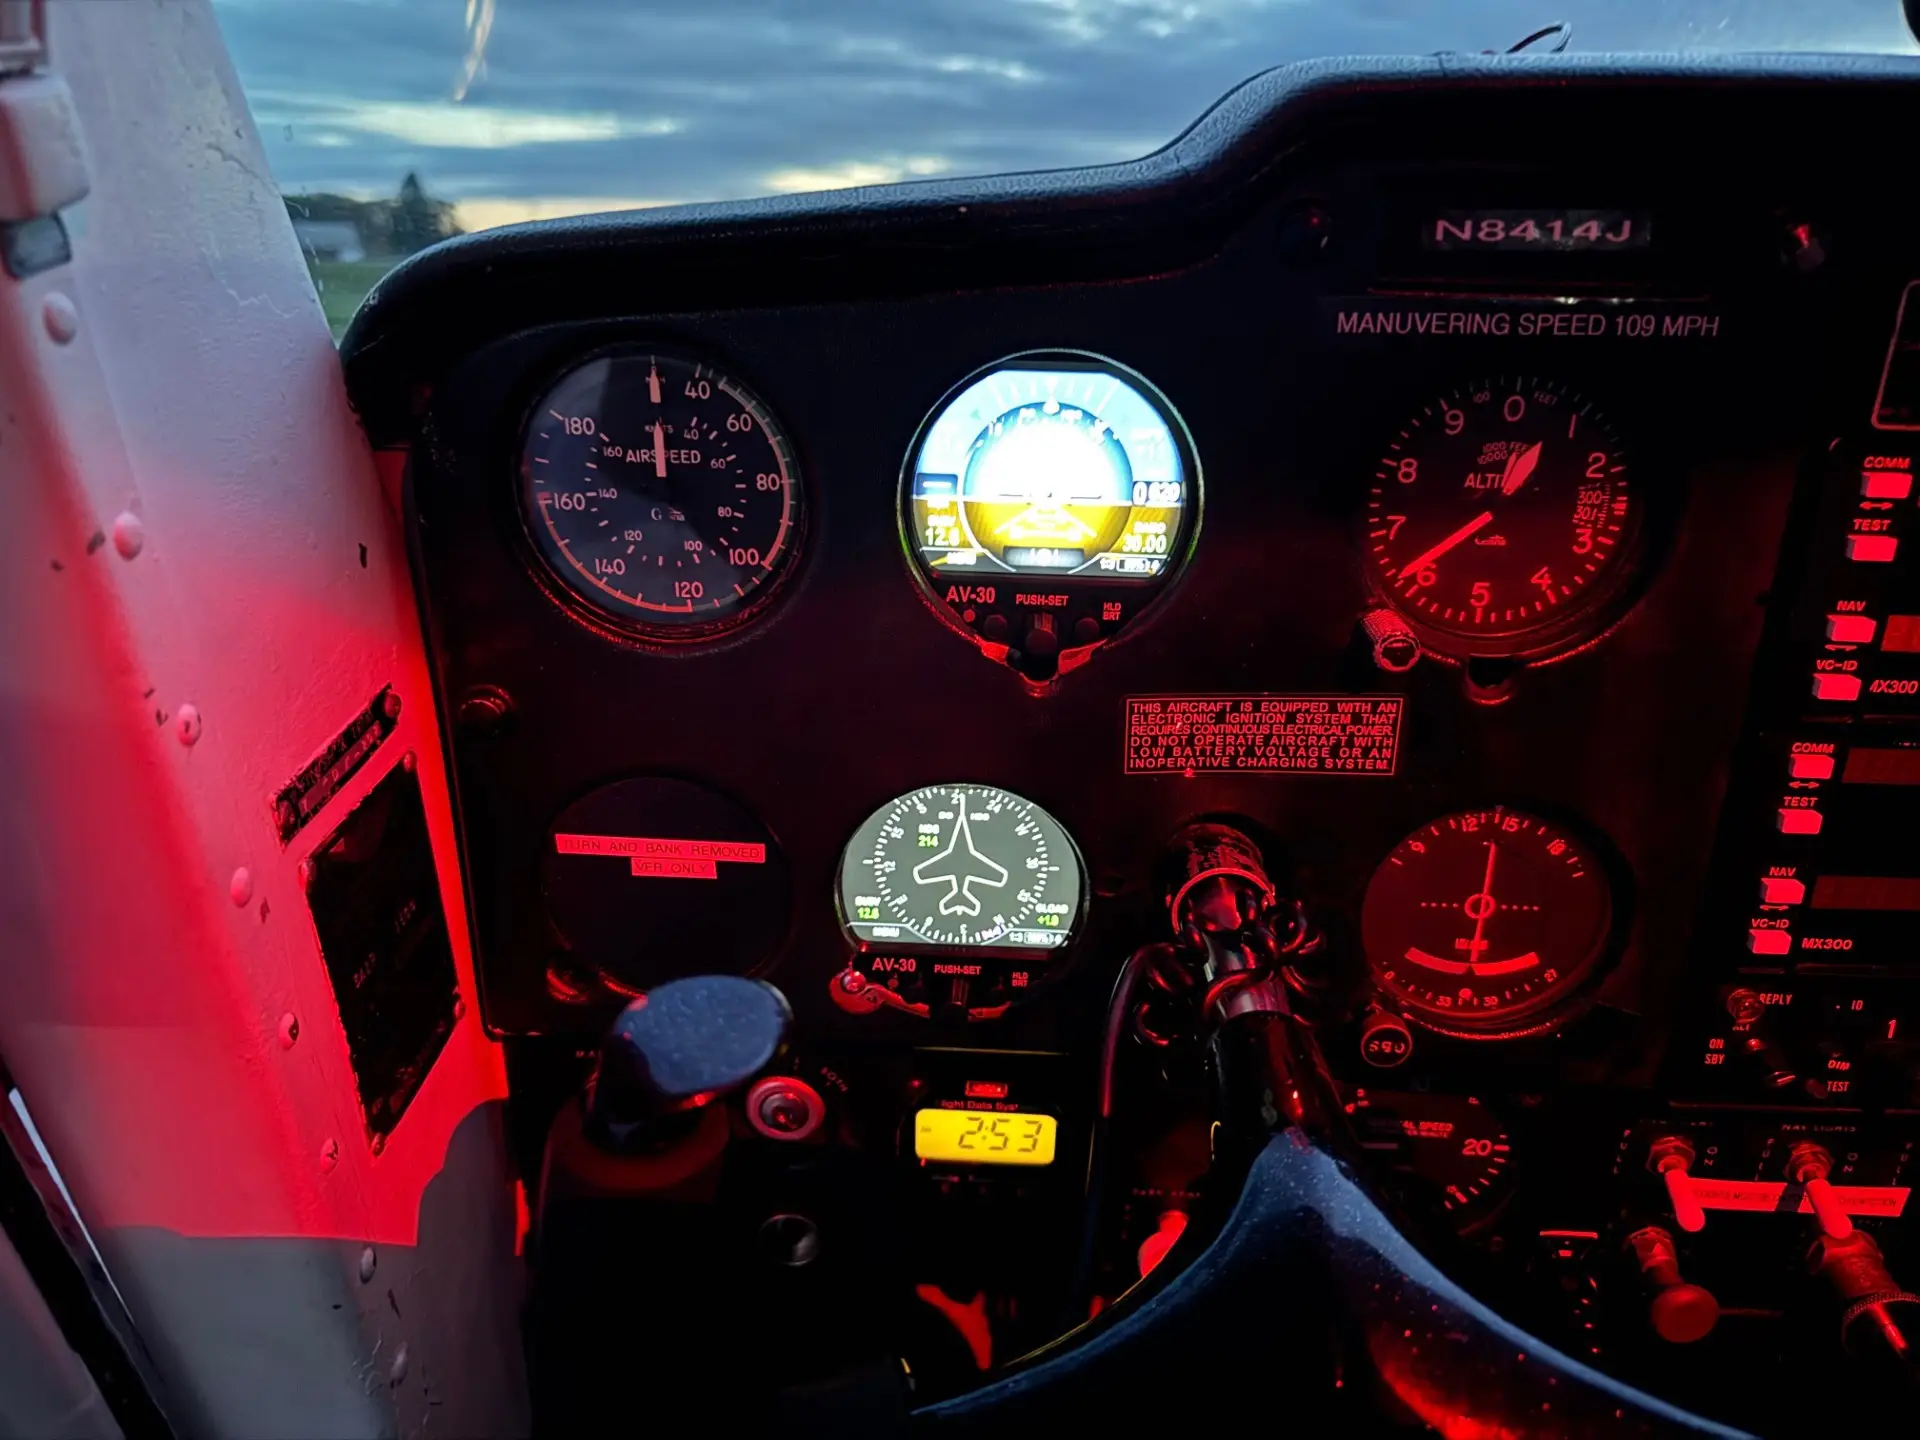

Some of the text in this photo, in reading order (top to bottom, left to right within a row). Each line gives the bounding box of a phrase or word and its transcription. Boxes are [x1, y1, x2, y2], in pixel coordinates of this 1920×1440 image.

[1435, 219, 1632, 243] N8414J
[1337, 312, 1720, 338] MANUVERING SPEED 109 MPH
[684, 380, 711, 399] 40
[1504, 395, 1525, 422] 0
[565, 417, 595, 435] 180
[727, 414, 752, 432] 60
[1444, 409, 1464, 435] 9
[684, 428, 699, 440] 40
[603, 446, 623, 457] 160
[1510, 441, 1531, 453] FEE
[711, 458, 726, 469] 60
[1586, 452, 1607, 478] 2
[1863, 456, 1911, 469] COMM
[1398, 458, 1418, 483] 8
[756, 473, 780, 491] 80
[598, 489, 618, 499] 140
[554, 493, 586, 510] 160
[718, 506, 732, 517] 80
[1387, 516, 1406, 541] 7
[1853, 519, 1891, 531] TEST
[624, 531, 643, 541] 120
[1572, 527, 1593, 554] 3
[684, 541, 703, 551] 100
[729, 549, 759, 565] 100
[595, 559, 626, 575] 140
[1416, 562, 1438, 586] 6
[1530, 566, 1552, 591] 4
[675, 581, 704, 598] 120
[946, 585, 996, 603] AV-30
[1470, 582, 1491, 607] 5
[1016, 593, 1069, 607] PUSH-SET
[1837, 601, 1866, 611] NAV
[1103, 602, 1121, 611] HLD
[1103, 611, 1121, 621] BRT
[1816, 660, 1858, 671] VC-ID
[1132, 703, 1396, 713] THIS AIRCRAFT IS EQUIPPED WITH AN
[1132, 714, 1396, 724] ELECTRONIC IGNITION SYSTEM THAT
[1131, 725, 1191, 735] REQUIRES
[1193, 725, 1270, 734] CONTINUOUS
[1272, 725, 1343, 735] ELECTRICAL
[1131, 736, 1393, 747] DO NOT OPERATE AIRCRAFT WITH
[1130, 746, 1392, 758] LOW BATTERY VOLTAGE OR AN
[1791, 742, 1835, 754] COMM
[1130, 758, 1230, 768] INOPERATIVE
[1237, 757, 1319, 768] CHARGING
[1783, 796, 1818, 807] TEST
[1461, 817, 1479, 833] 12
[1502, 817, 1519, 832] 15
[609, 842, 638, 853] AND
[646, 843, 682, 855] BANK
[691, 846, 760, 859] REMOVED
[635, 862, 709, 874] VFR ONLY
[1769, 867, 1796, 876] NAV
[1751, 919, 1789, 928] VC-ID
[1802, 938, 1853, 950] MX300
[872, 958, 916, 973] AV-30
[934, 963, 982, 976] PUSH-SET
[1012, 972, 1029, 980] HLD
[1012, 979, 1028, 988] BRT
[1483, 996, 1499, 1007] 30
[1759, 993, 1792, 1006] REPLY
[1887, 1019, 1897, 1038] 1
[1709, 1038, 1724, 1049] ON
[1704, 1053, 1726, 1065] SBY
[1827, 1081, 1850, 1092] TEST
[958, 1116, 1043, 1153] 2:53
[1462, 1139, 1493, 1156] 20
